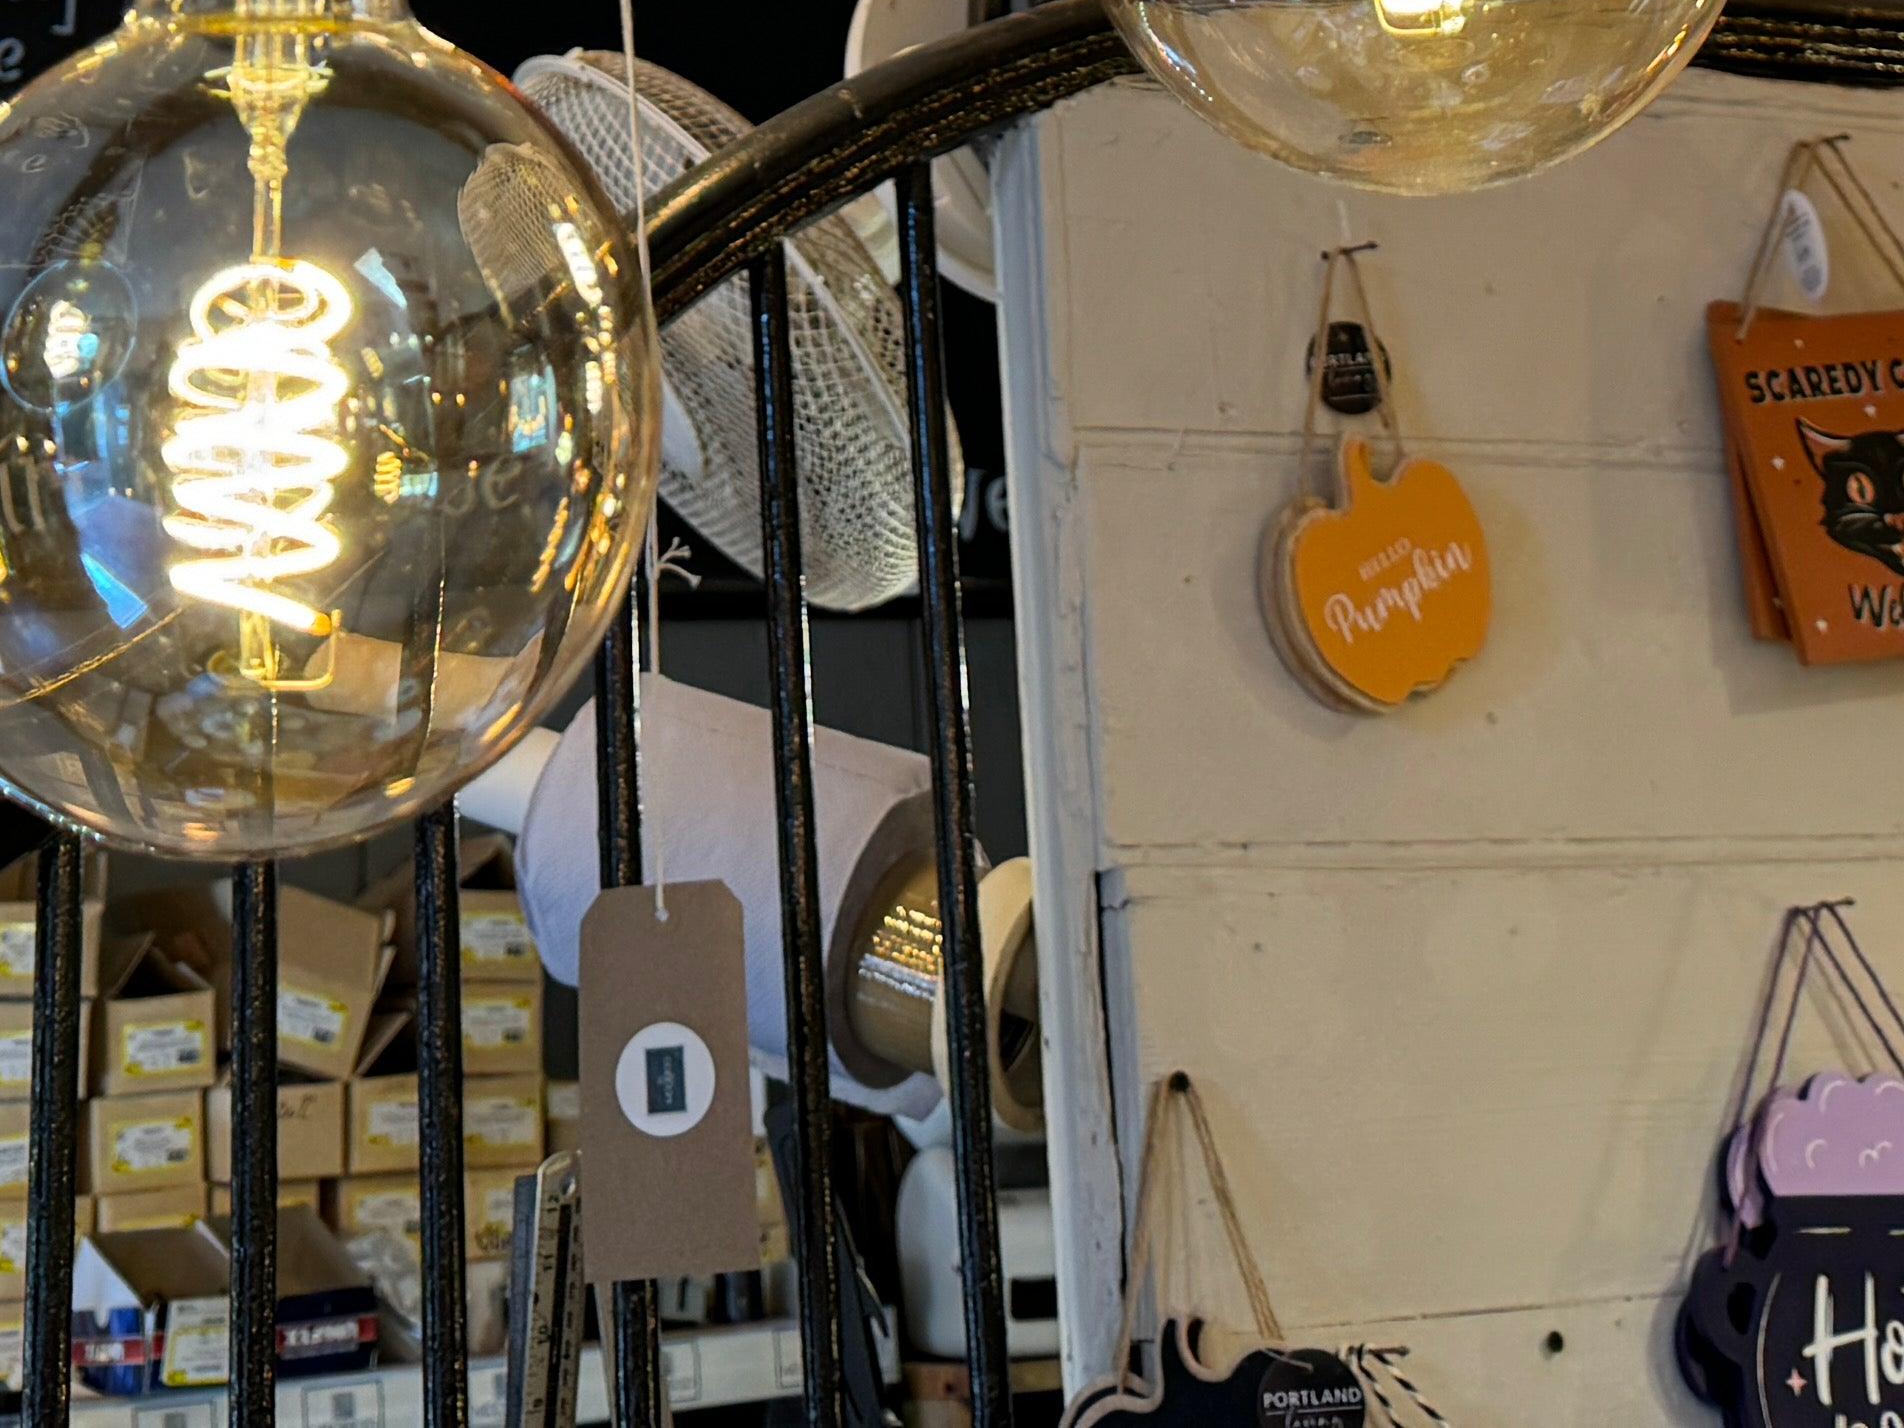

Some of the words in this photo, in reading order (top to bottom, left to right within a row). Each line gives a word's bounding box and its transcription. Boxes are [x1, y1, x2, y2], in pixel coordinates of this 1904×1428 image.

[1745, 359, 1884, 405] SCAREDY
[1324, 541, 1472, 645] Pumpkin
[1262, 1386, 1363, 1409] PORTLAND
